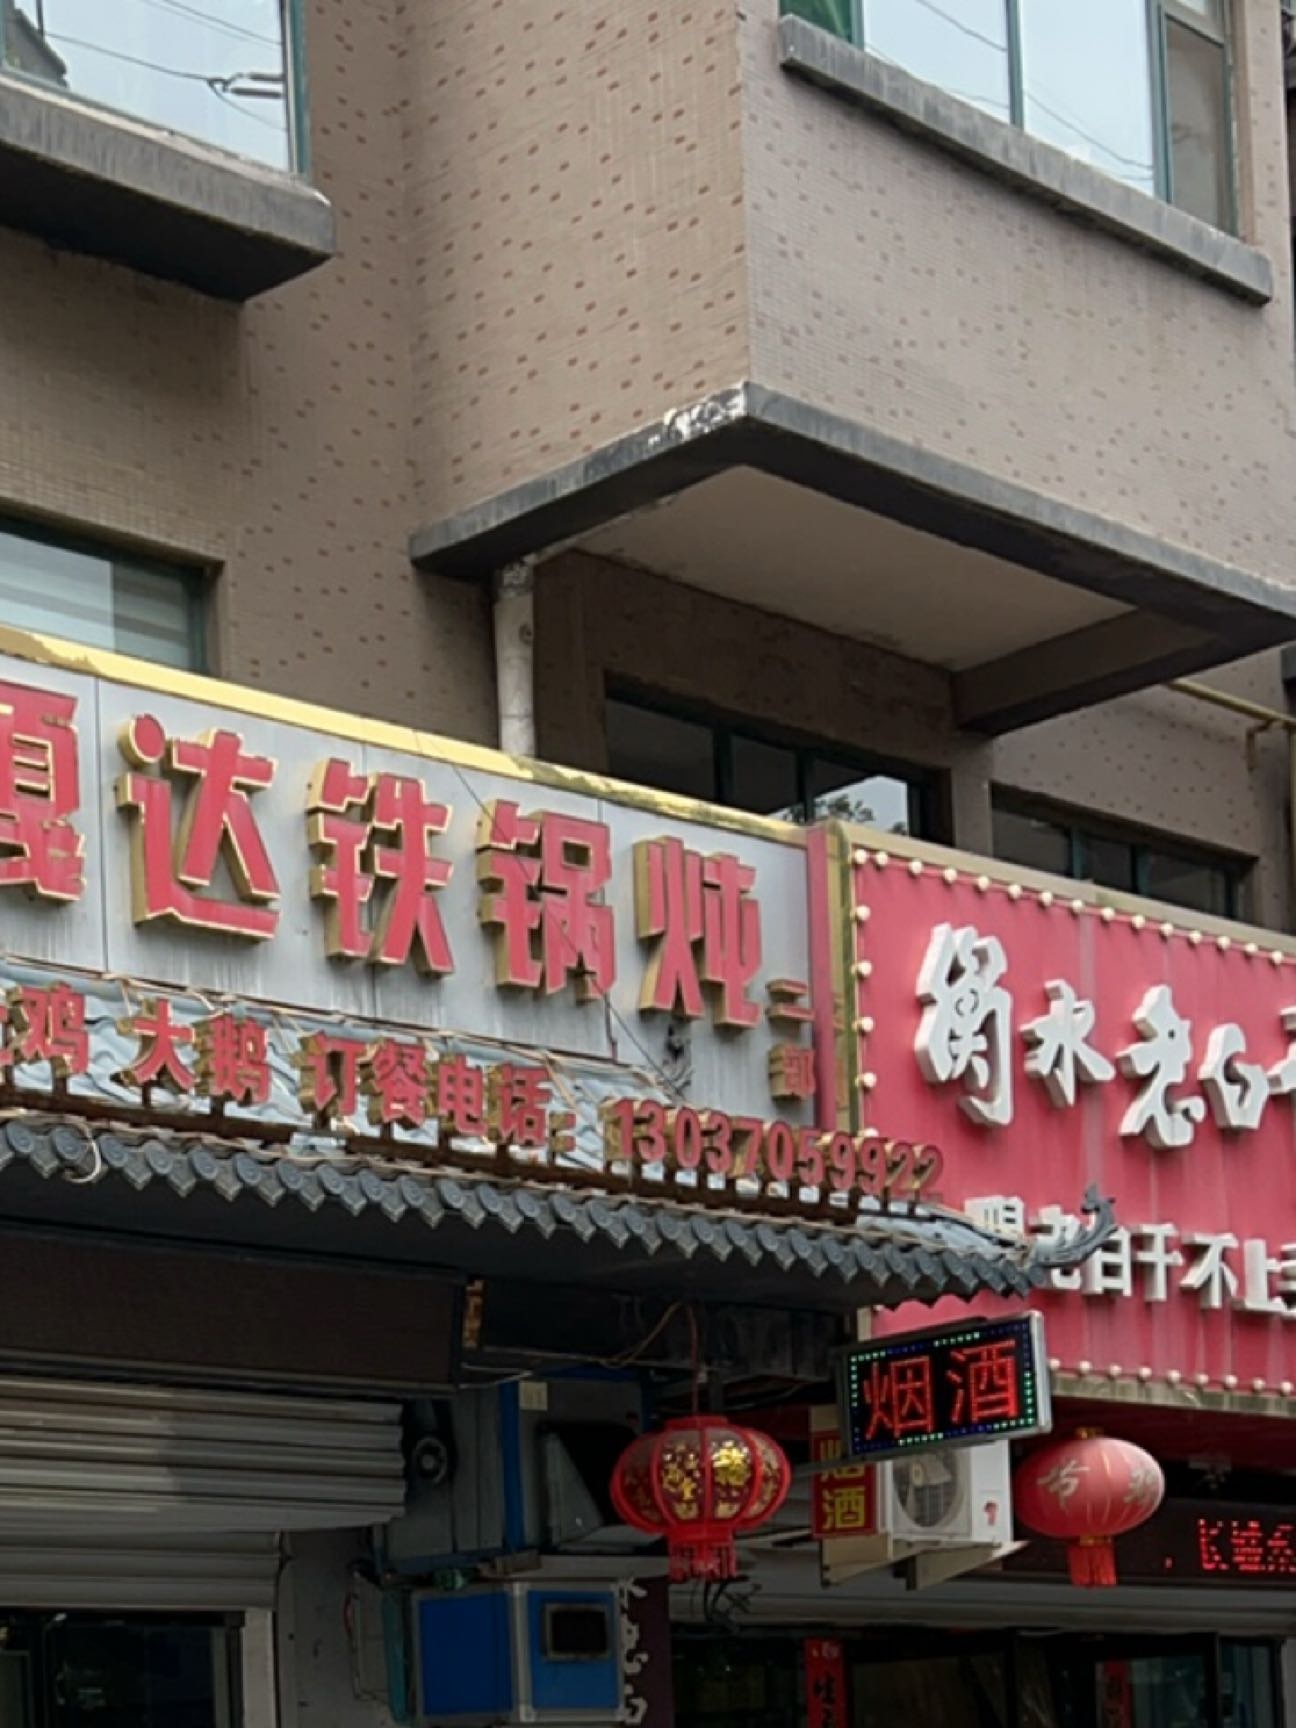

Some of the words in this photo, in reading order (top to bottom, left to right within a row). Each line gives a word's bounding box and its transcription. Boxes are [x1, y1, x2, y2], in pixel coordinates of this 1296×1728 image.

[109, 998, 271, 1106] 大鹅
[599, 1098, 944, 1204] 13037059922
[863, 1338, 1020, 1440] 烟酒
